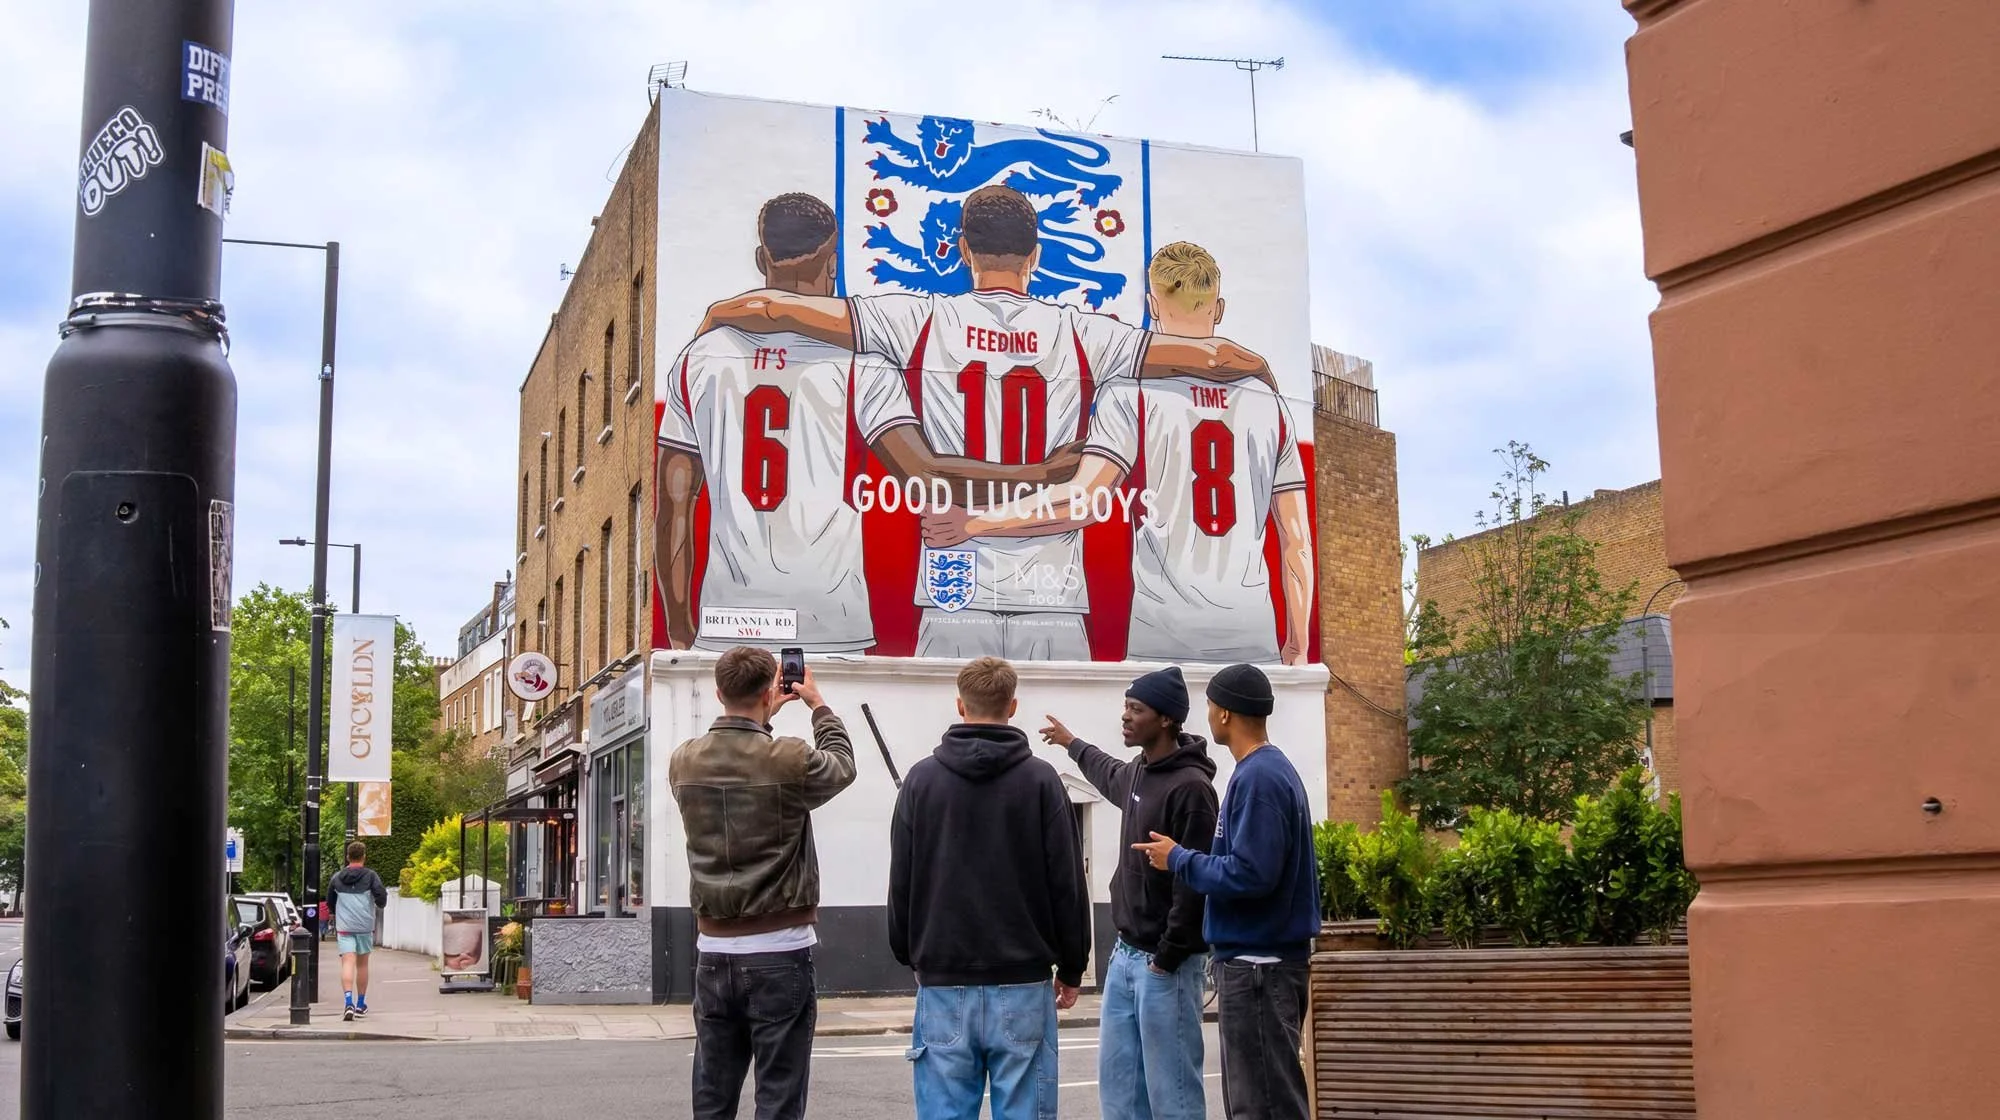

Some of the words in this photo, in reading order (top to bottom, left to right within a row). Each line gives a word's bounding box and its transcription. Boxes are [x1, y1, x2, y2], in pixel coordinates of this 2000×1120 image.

[82, 126, 162, 212] OUT!
[966, 326, 1038, 354] FEEDING
[754, 347, 787, 370] IT'S
[1190, 386, 1229, 410] TIME
[956, 360, 1047, 466] 10
[741, 384, 791, 513] 6
[1190, 419, 1237, 537] 8
[852, 473, 952, 515] GOOD
[966, 479, 1057, 520] LUCK
[1068, 484, 1160, 527] BOYS
[1014, 562, 1079, 590] M&S
[1029, 594, 1066, 605] FOOD
[705, 615, 770, 626] BRITANNIA
[775, 618, 795, 627] RD.
[737, 627, 761, 637] SW6
